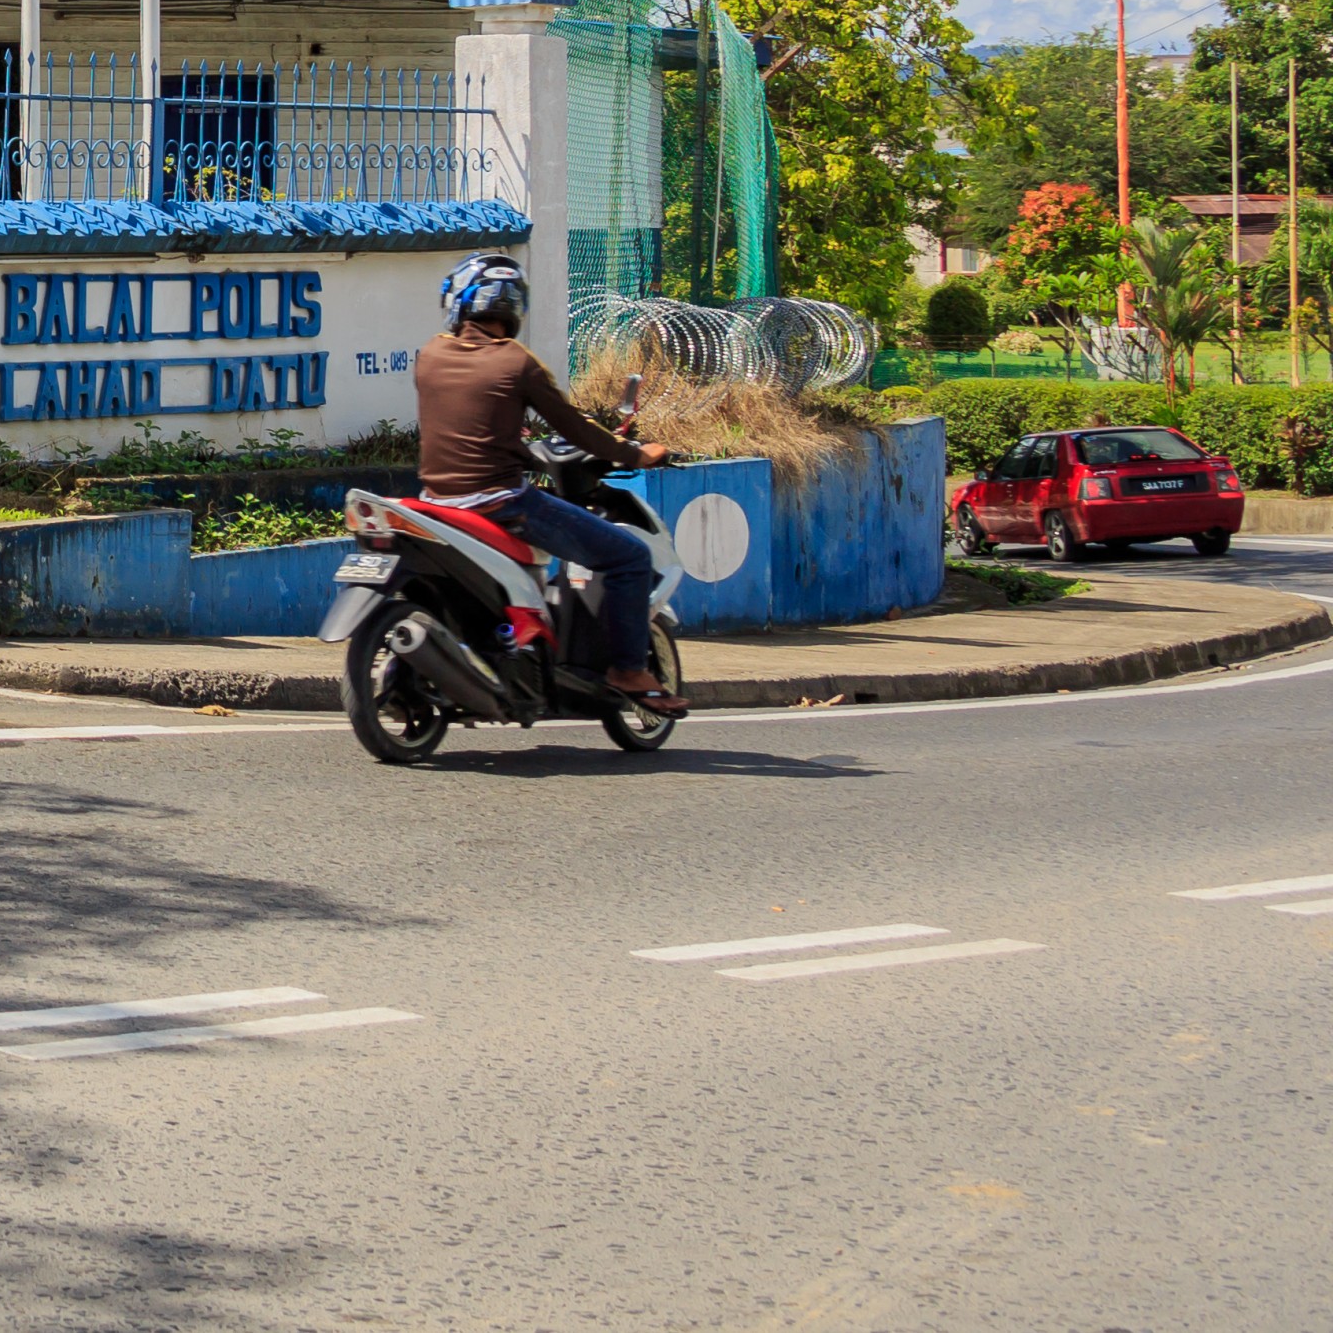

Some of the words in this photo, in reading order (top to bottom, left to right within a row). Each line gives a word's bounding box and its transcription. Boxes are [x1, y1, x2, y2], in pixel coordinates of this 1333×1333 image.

[1, 273, 154, 345] BALAI
[191, 271, 323, 341] POLIS
[212, 351, 330, 413] DATU
